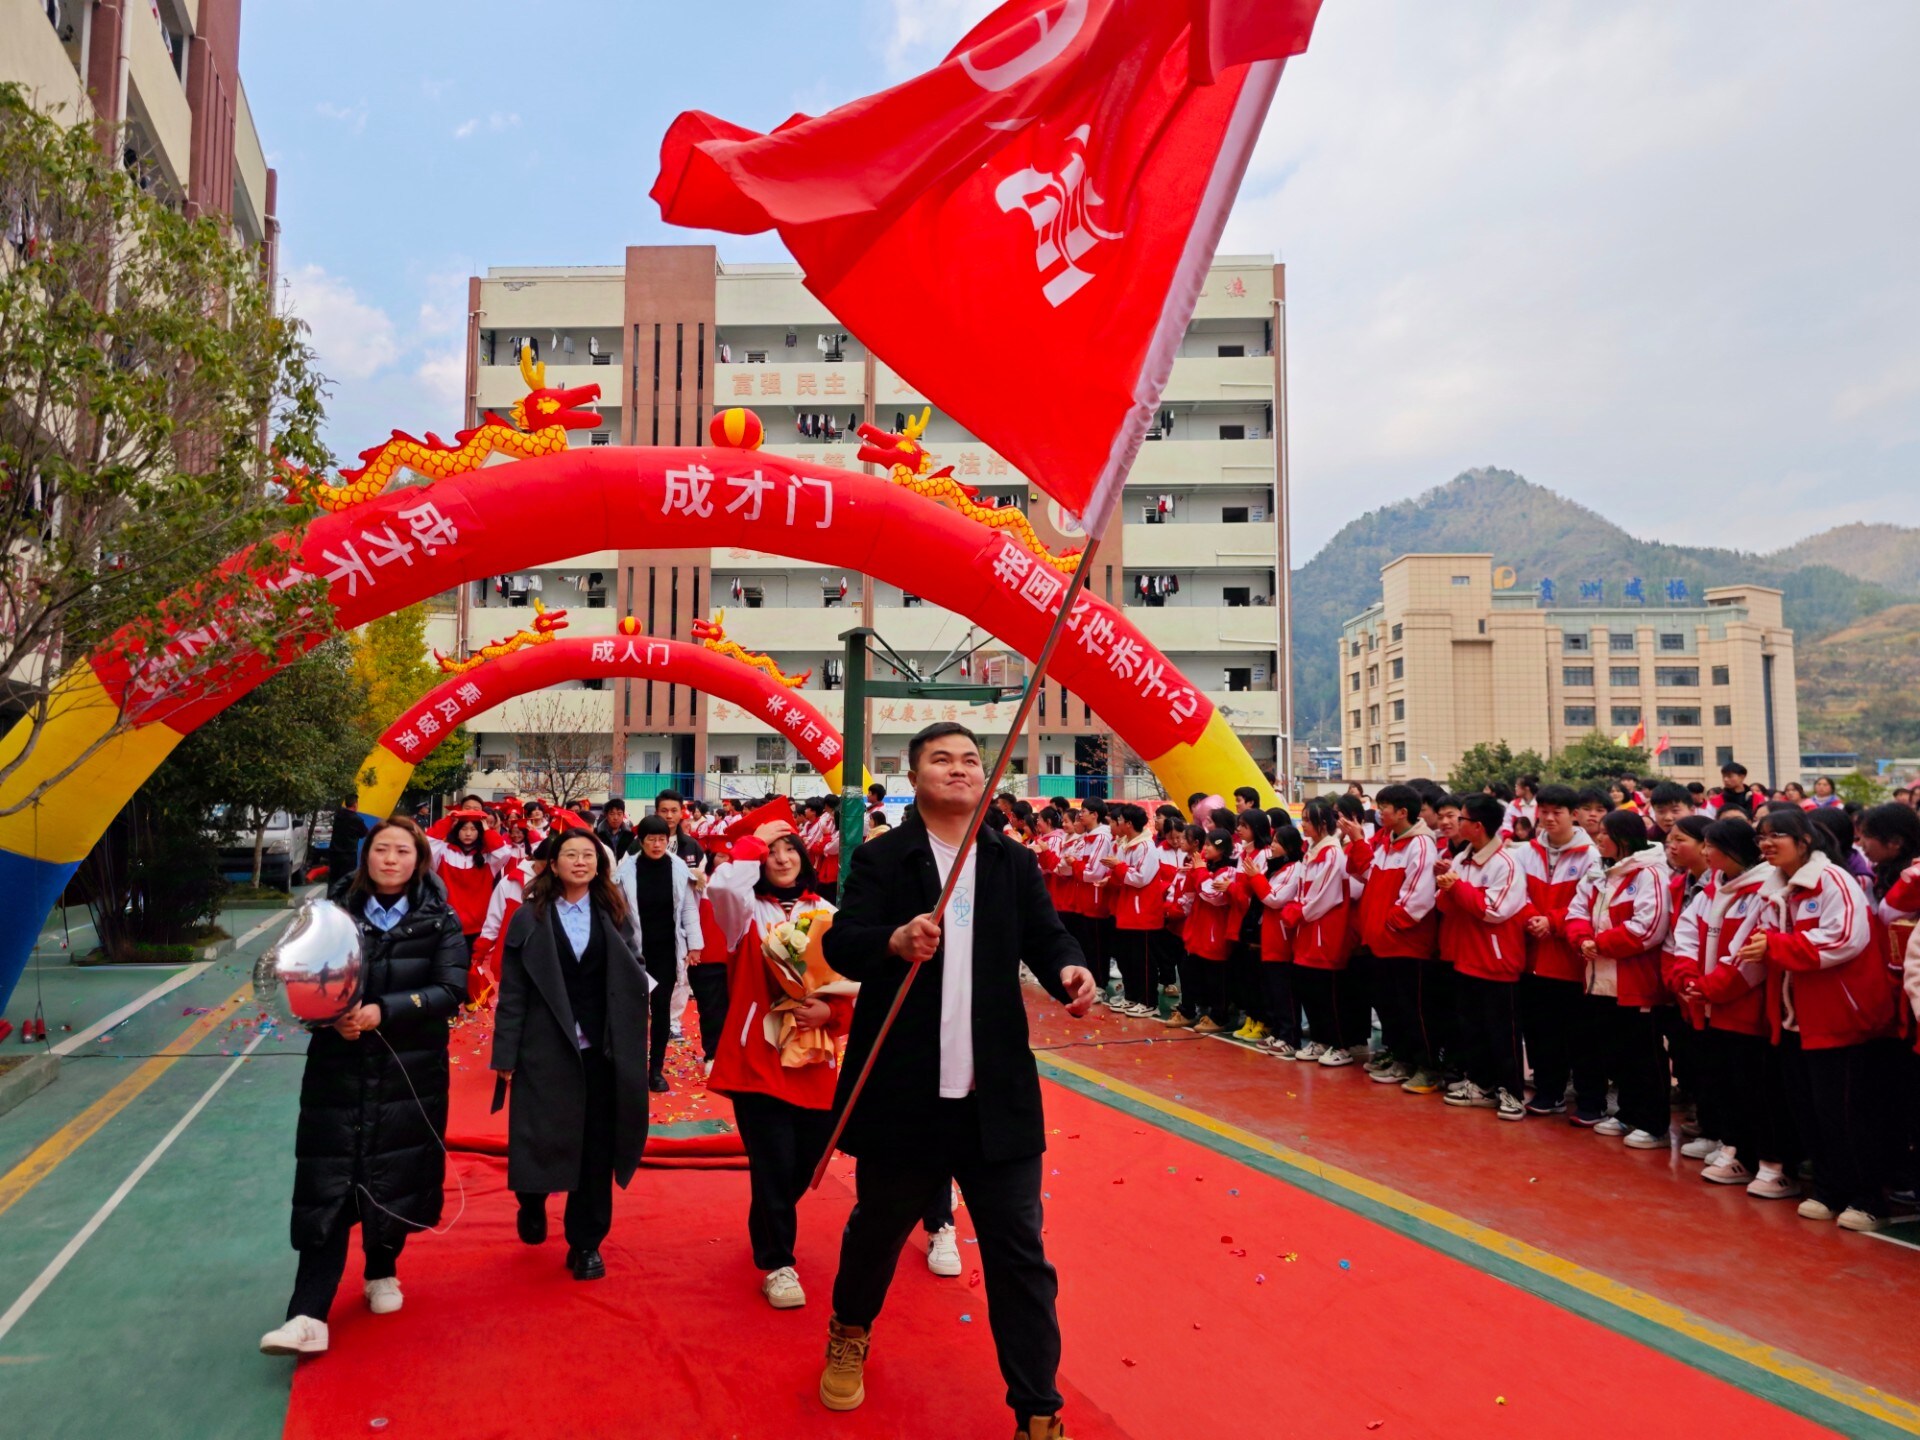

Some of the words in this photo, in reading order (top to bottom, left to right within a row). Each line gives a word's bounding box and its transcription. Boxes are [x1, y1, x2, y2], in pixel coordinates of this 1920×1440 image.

[732, 373, 782, 396] 富强
[796, 373, 846, 396] 民主
[660, 462, 834, 529] 成才门
[958, 453, 1008, 476] 法治
[590, 640, 671, 666] 成人门
[992, 542, 1198, 725] 报国长存赤子心
[394, 681, 484, 754] 乘风破浪
[765, 694, 841, 760] 未来可期
